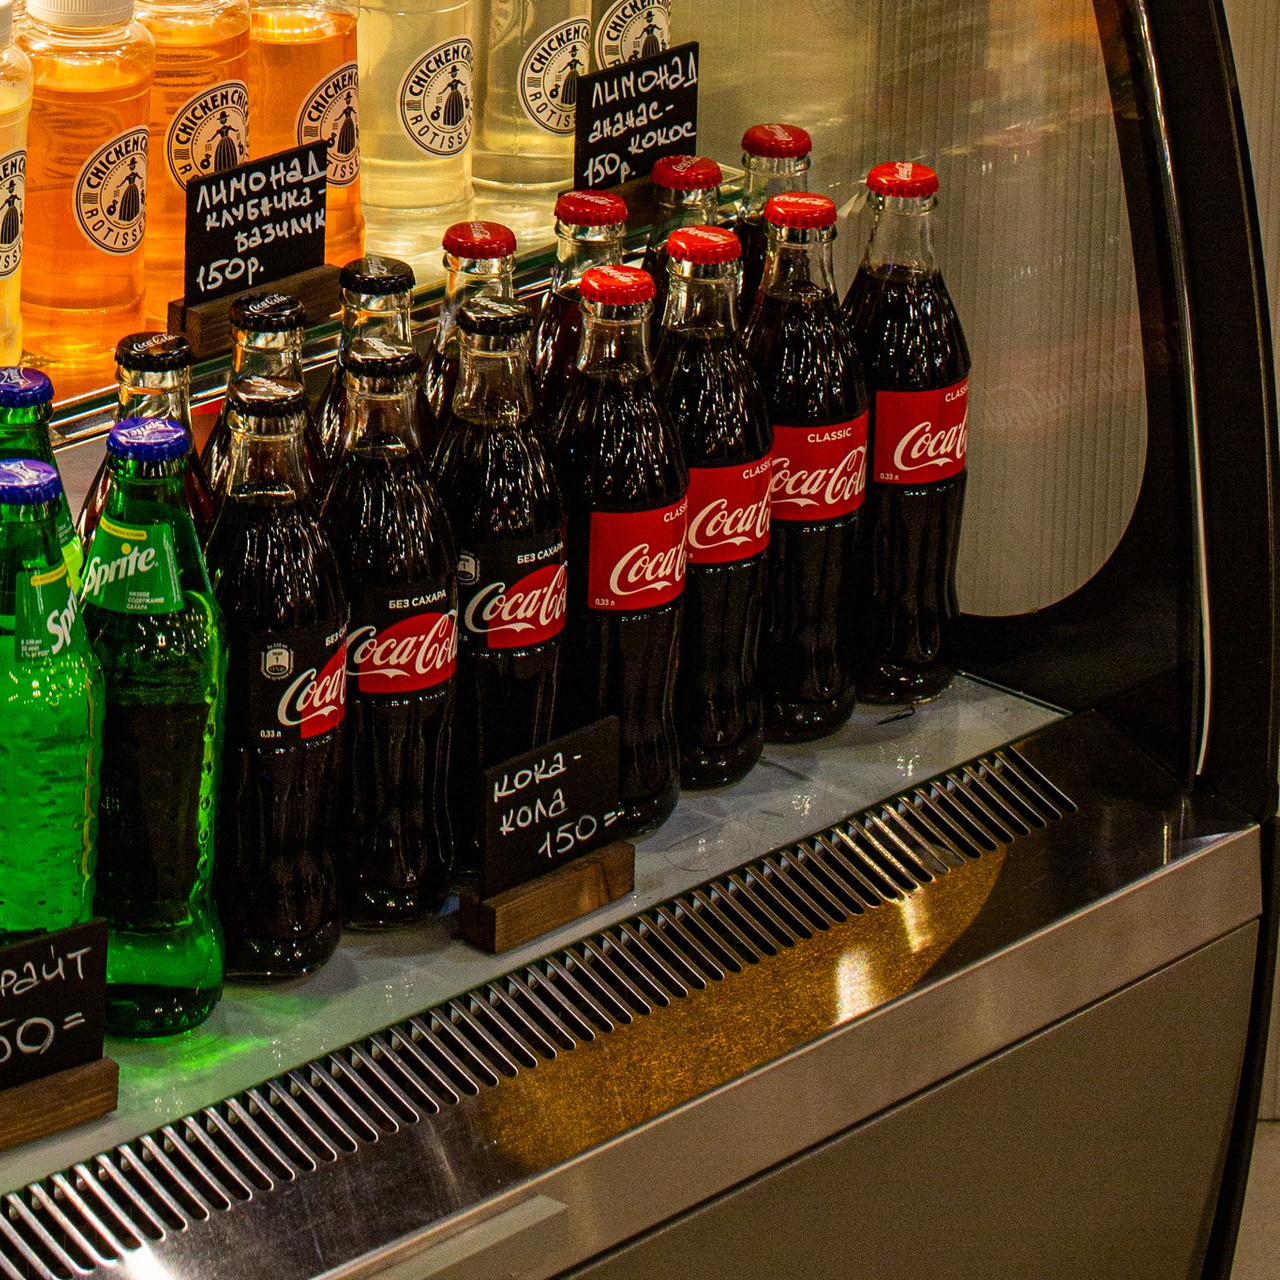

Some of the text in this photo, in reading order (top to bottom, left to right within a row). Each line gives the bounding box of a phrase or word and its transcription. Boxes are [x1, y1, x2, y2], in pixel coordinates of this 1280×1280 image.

[406, 45, 459, 97] CHICKEN
[530, 26, 581, 73] CHICKEN
[175, 90, 229, 145] CHICKEN
[308, 71, 352, 122] CHICKEN
[86, 136, 137, 189] CHICKEN
[807, 427, 852, 443] CLASSIC
[84, 545, 157, 596] Sprite
[517, 554, 536, 564] БЕЗ
[389, 589, 447, 609] БЕЗ САХАРА
